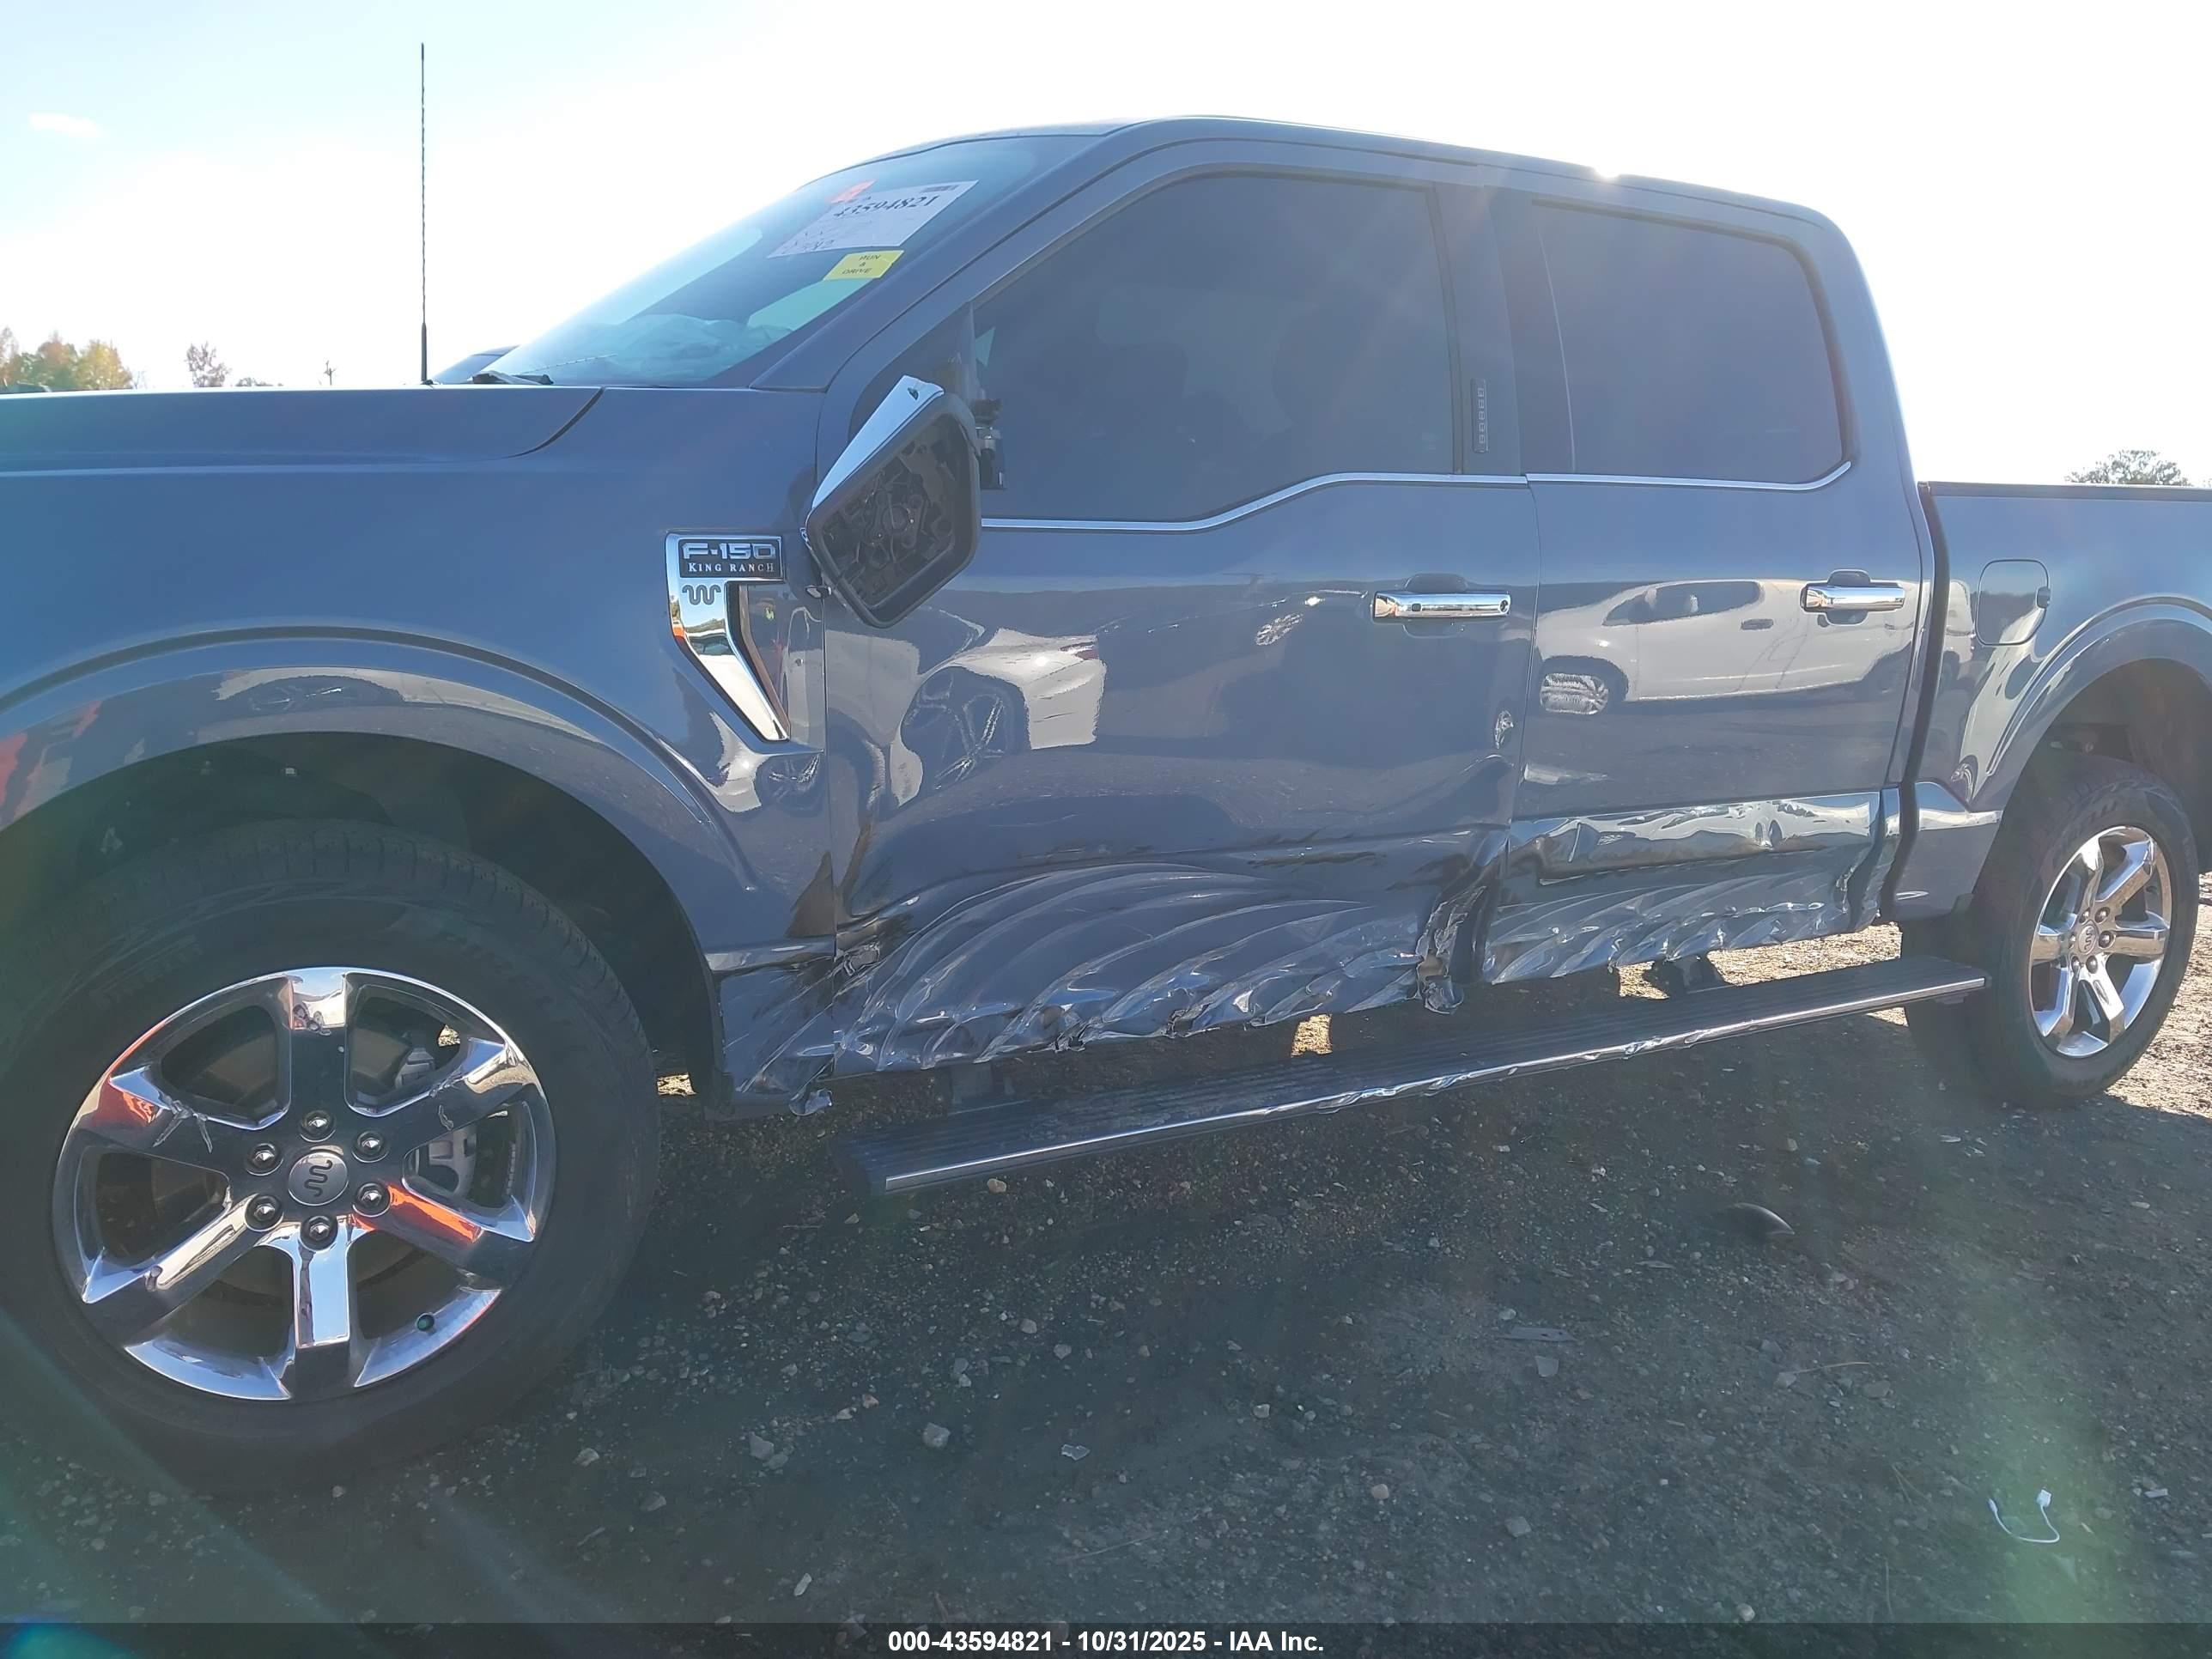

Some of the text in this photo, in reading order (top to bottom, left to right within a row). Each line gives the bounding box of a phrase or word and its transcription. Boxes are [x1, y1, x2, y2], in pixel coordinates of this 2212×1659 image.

[682, 543, 776, 560] F-150
[689, 562, 775, 573] KING RANCH
